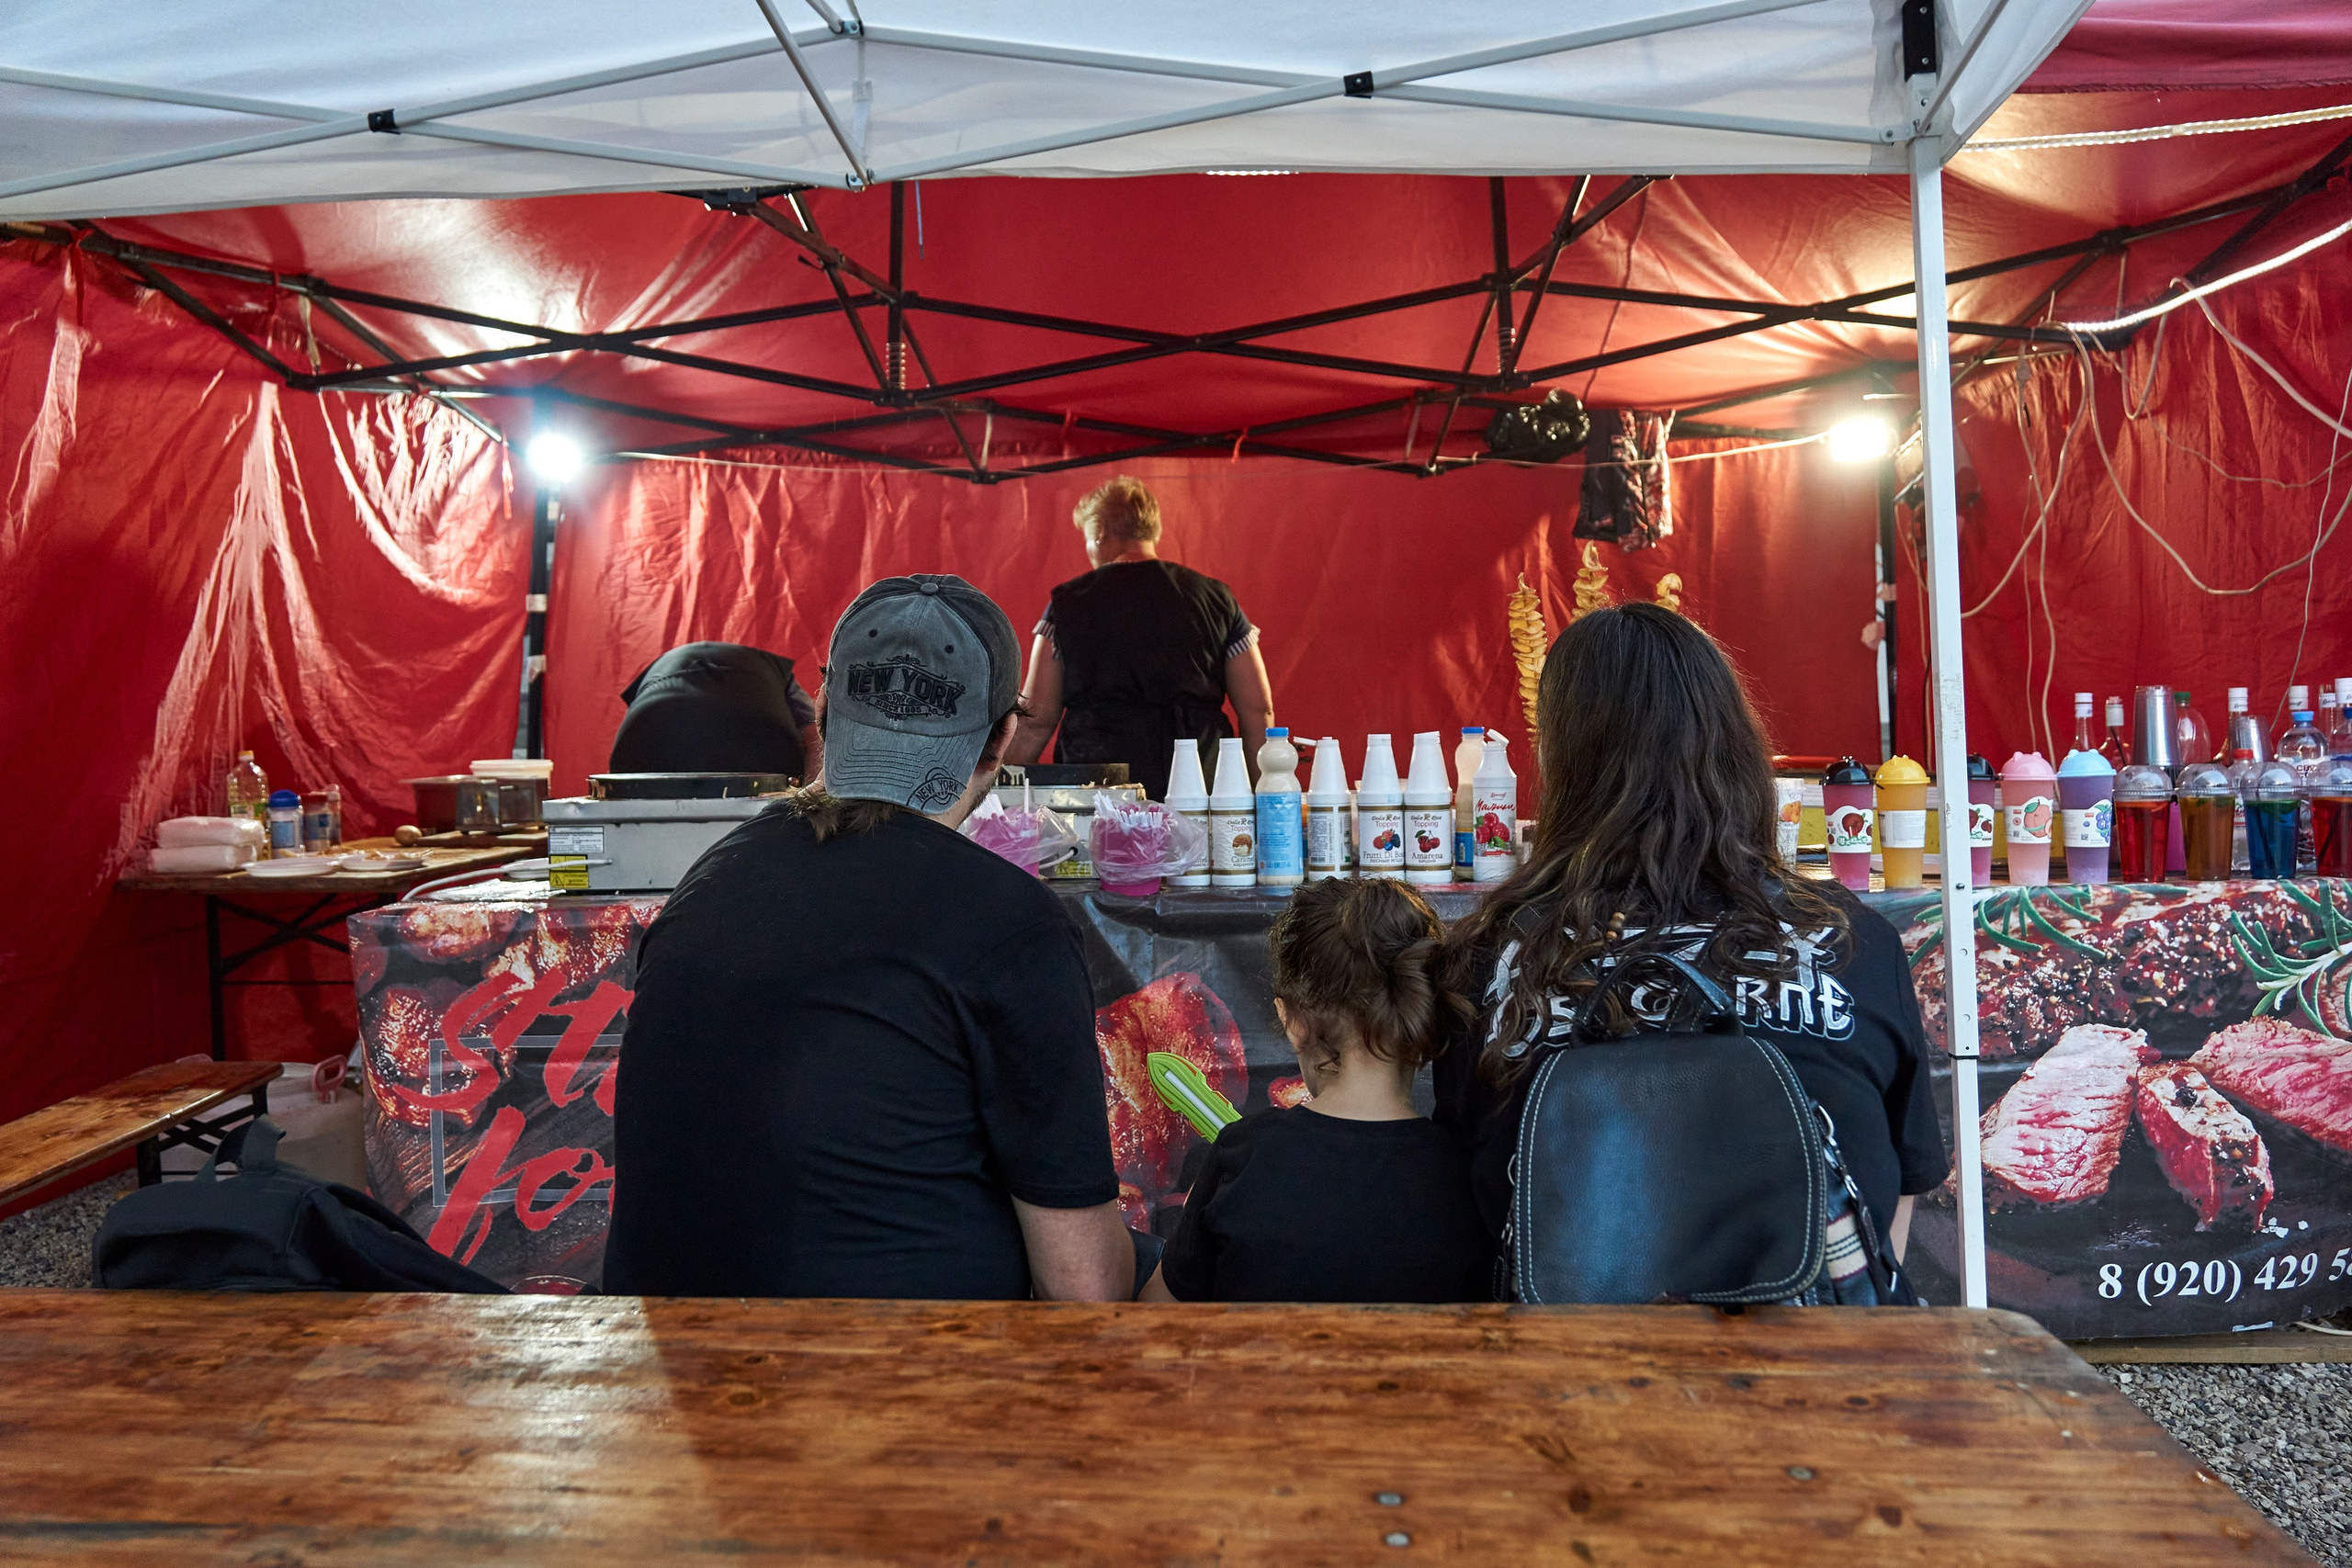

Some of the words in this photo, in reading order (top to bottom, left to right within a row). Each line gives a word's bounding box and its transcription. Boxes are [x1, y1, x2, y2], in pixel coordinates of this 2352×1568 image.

[847, 668, 895, 696] NEW
[901, 668, 963, 714] YORK
[914, 782, 935, 803] NEW
[937, 779, 959, 794] YORK
[1363, 851, 1382, 859] Frutti
[2098, 1263, 2122, 1299] 8
[2136, 1259, 2242, 1306] (920)
[2254, 1252, 2318, 1291] 429
